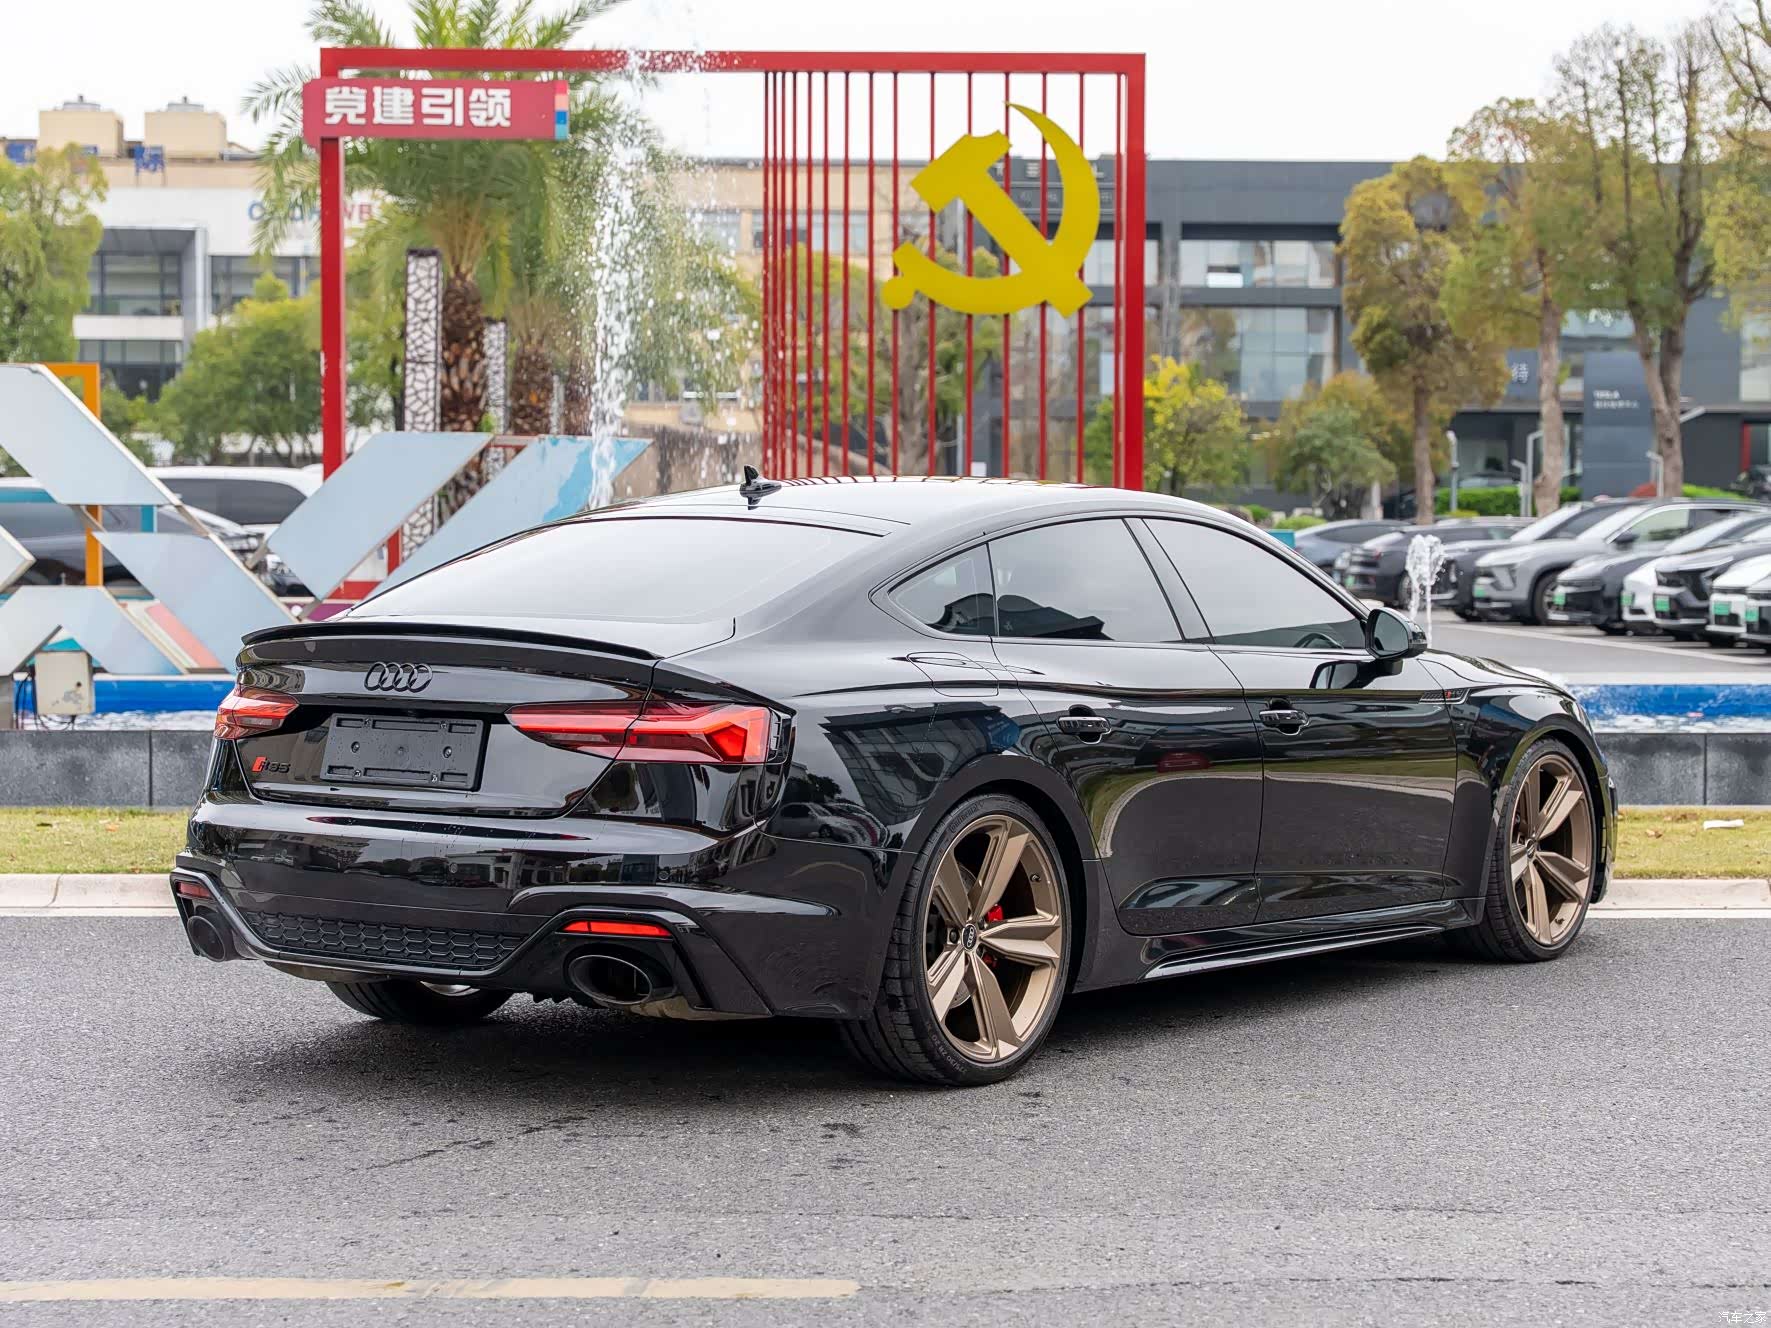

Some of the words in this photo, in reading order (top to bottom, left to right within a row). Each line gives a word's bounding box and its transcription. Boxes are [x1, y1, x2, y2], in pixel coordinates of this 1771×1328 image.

[324, 86, 511, 127] 党建引领
[252, 756, 291, 773] RS5
